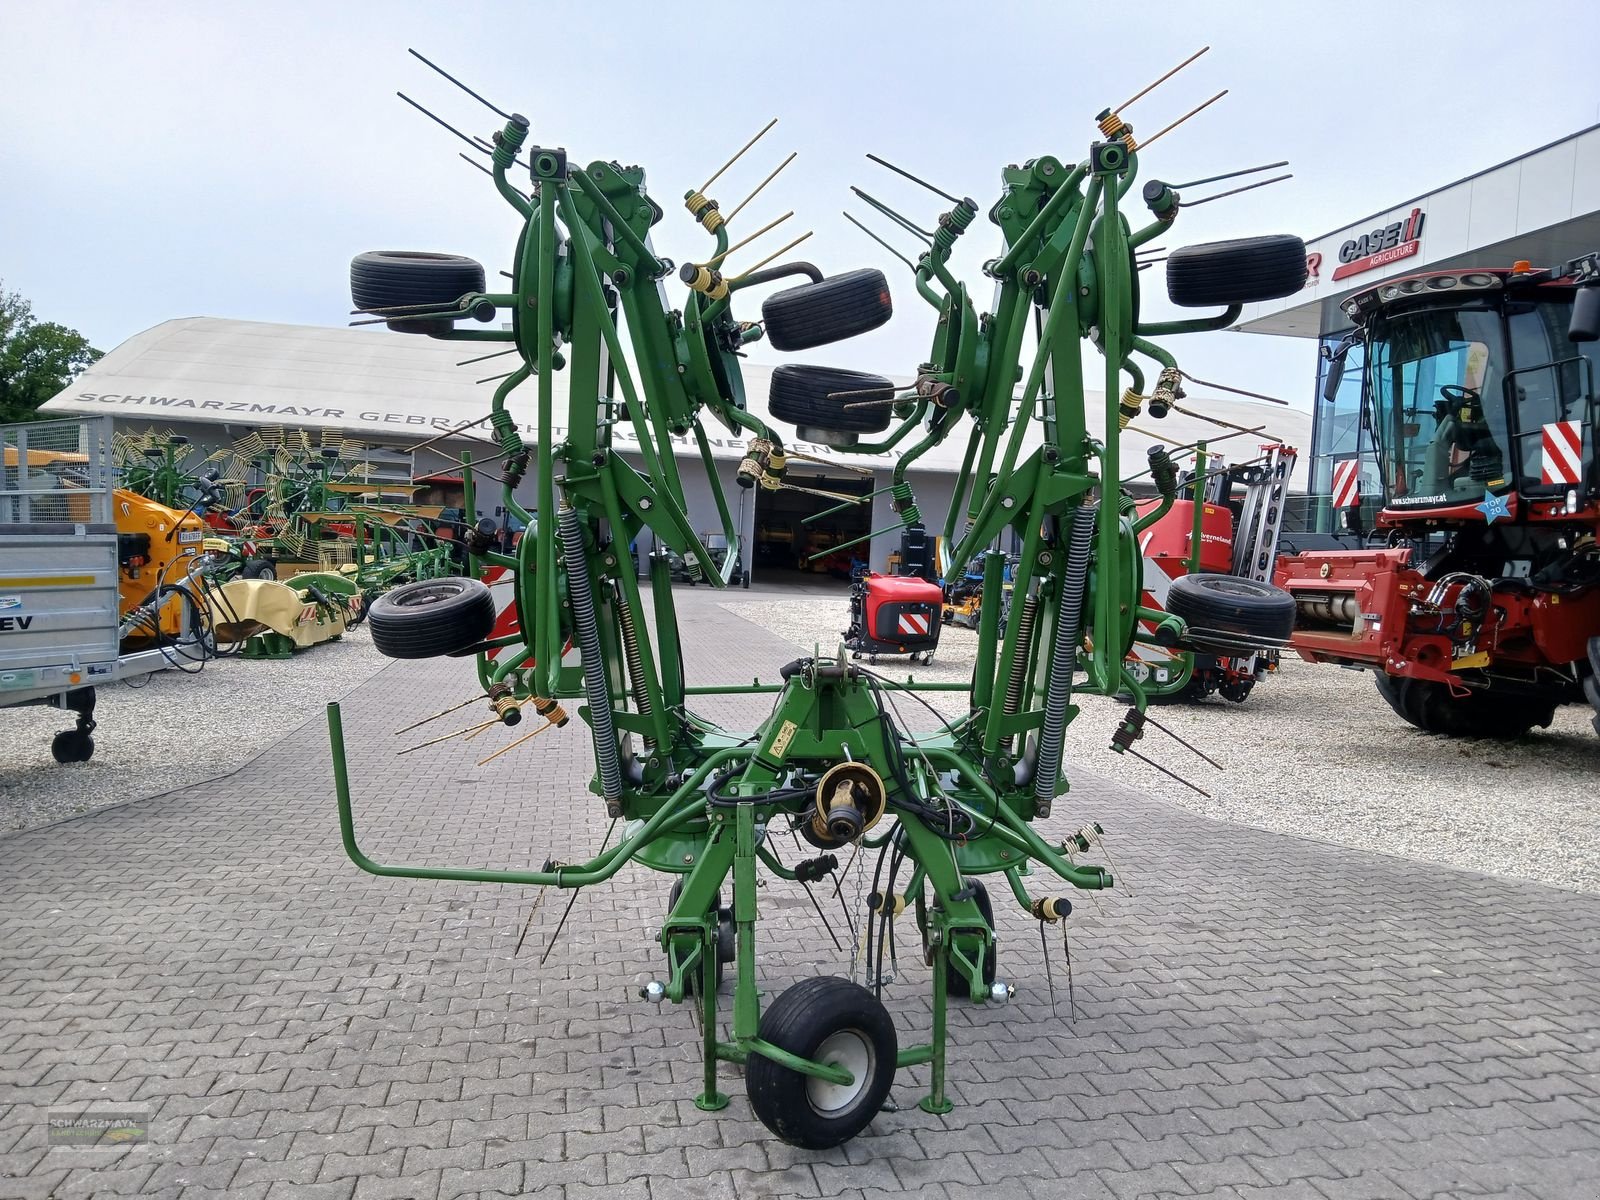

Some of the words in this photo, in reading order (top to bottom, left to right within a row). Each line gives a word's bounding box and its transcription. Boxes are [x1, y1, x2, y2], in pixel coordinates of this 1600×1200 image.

[1339, 221, 1402, 263] CASE
[1369, 244, 1414, 267] AGRICULTURE
[74, 393, 345, 418] SCHWARZMAYR
[1391, 493, 1447, 506] www.schwarzmayr.at
[1484, 498, 1502, 509] TOP
[1490, 507, 1501, 516] 20
[1200, 531, 1232, 545] verneland
